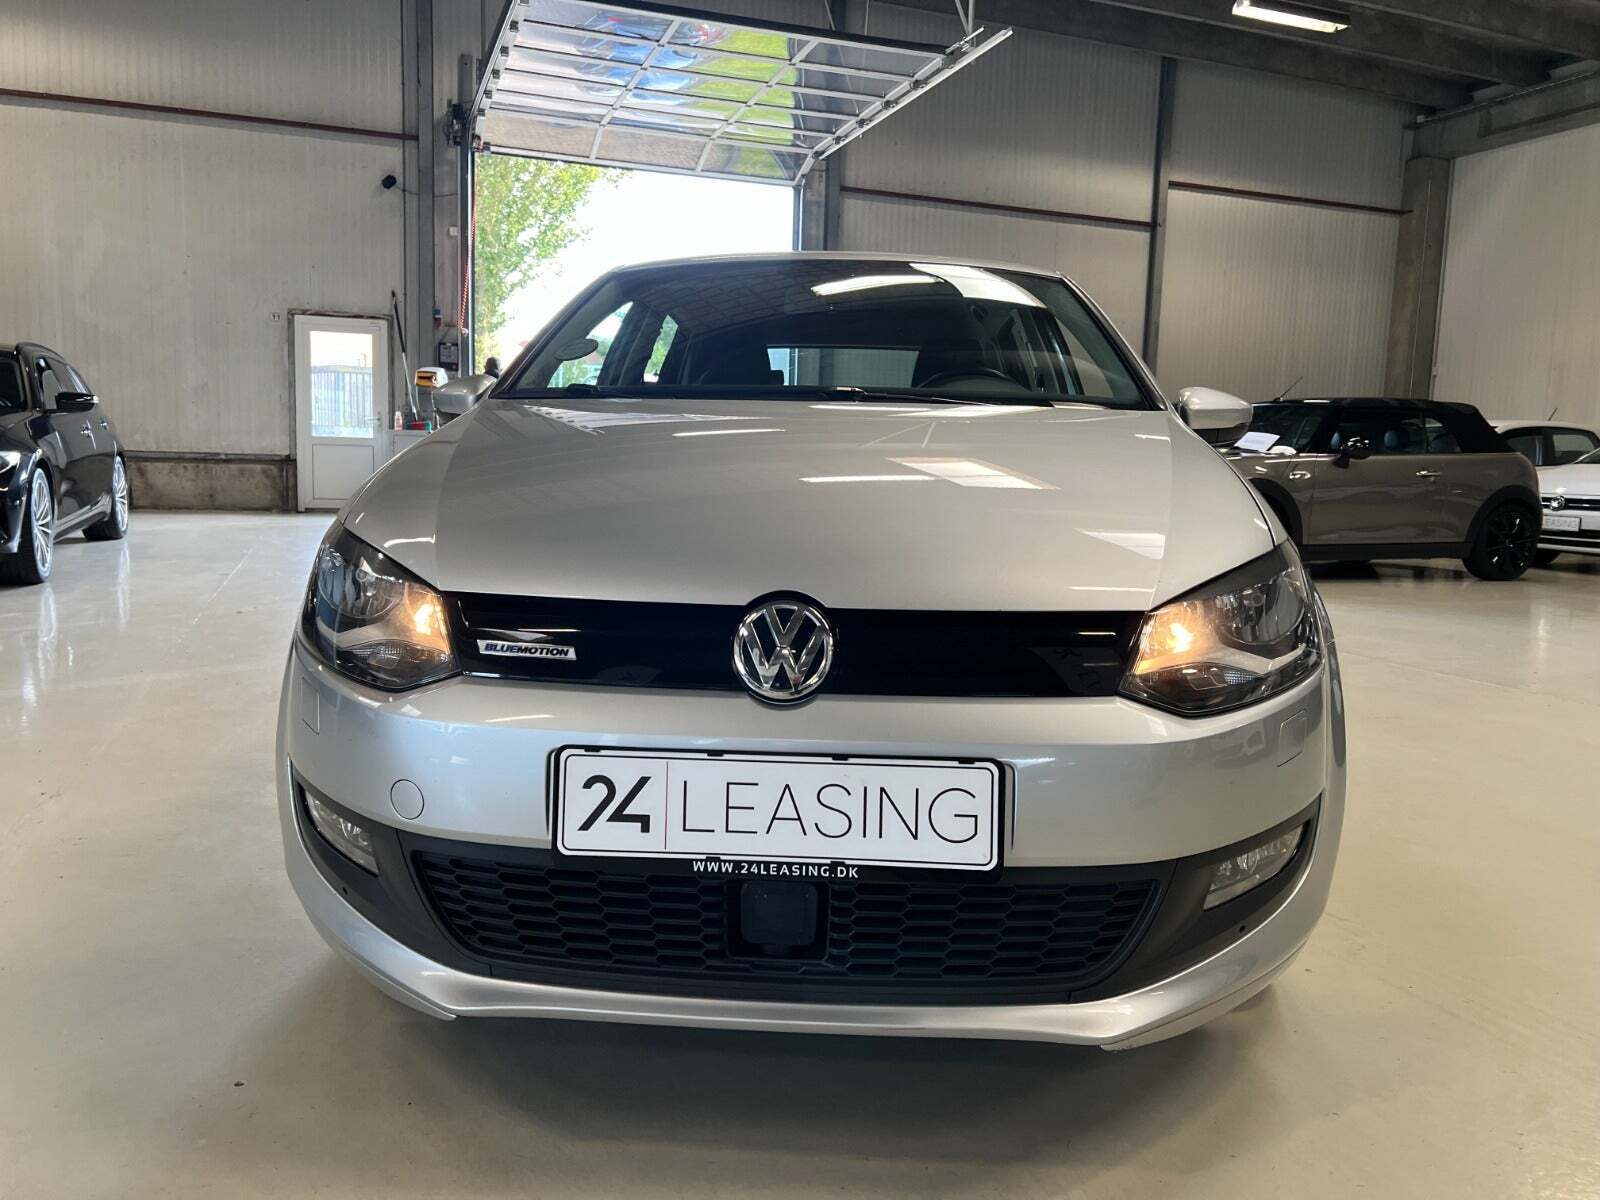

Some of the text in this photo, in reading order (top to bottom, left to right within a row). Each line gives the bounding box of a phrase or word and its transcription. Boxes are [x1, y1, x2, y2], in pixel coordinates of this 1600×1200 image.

[484, 643, 569, 657] BLUEMOTION
[736, 603, 830, 697] VW
[577, 774, 978, 844] 24 LEASING
[692, 860, 859, 879] WWW.24LEASING.DK
